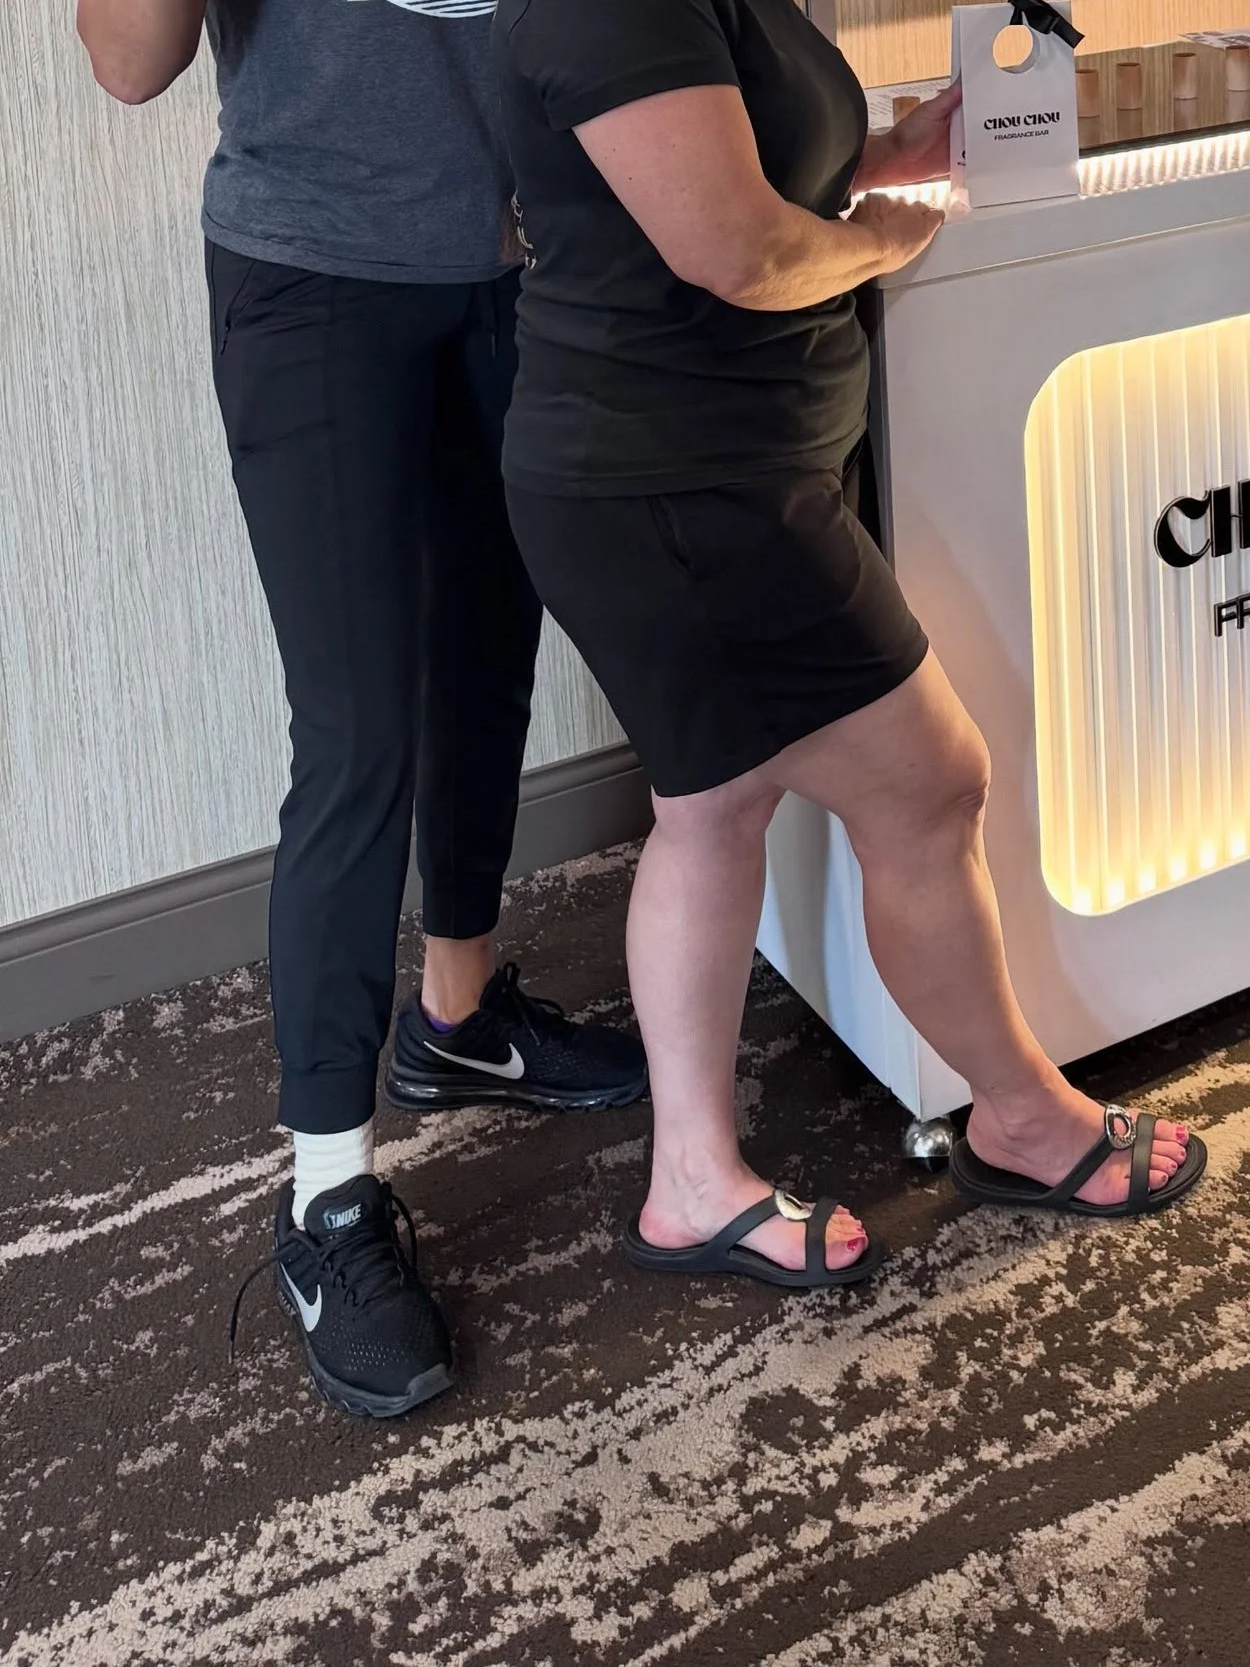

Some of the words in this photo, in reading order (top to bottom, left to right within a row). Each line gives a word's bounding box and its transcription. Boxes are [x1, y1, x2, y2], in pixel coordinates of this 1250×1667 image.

[984, 116, 1021, 130] CHOU
[1023, 111, 1060, 126] CHOU
[994, 131, 1034, 141] FRAGRANCE
[1034, 129, 1049, 137] BAR
